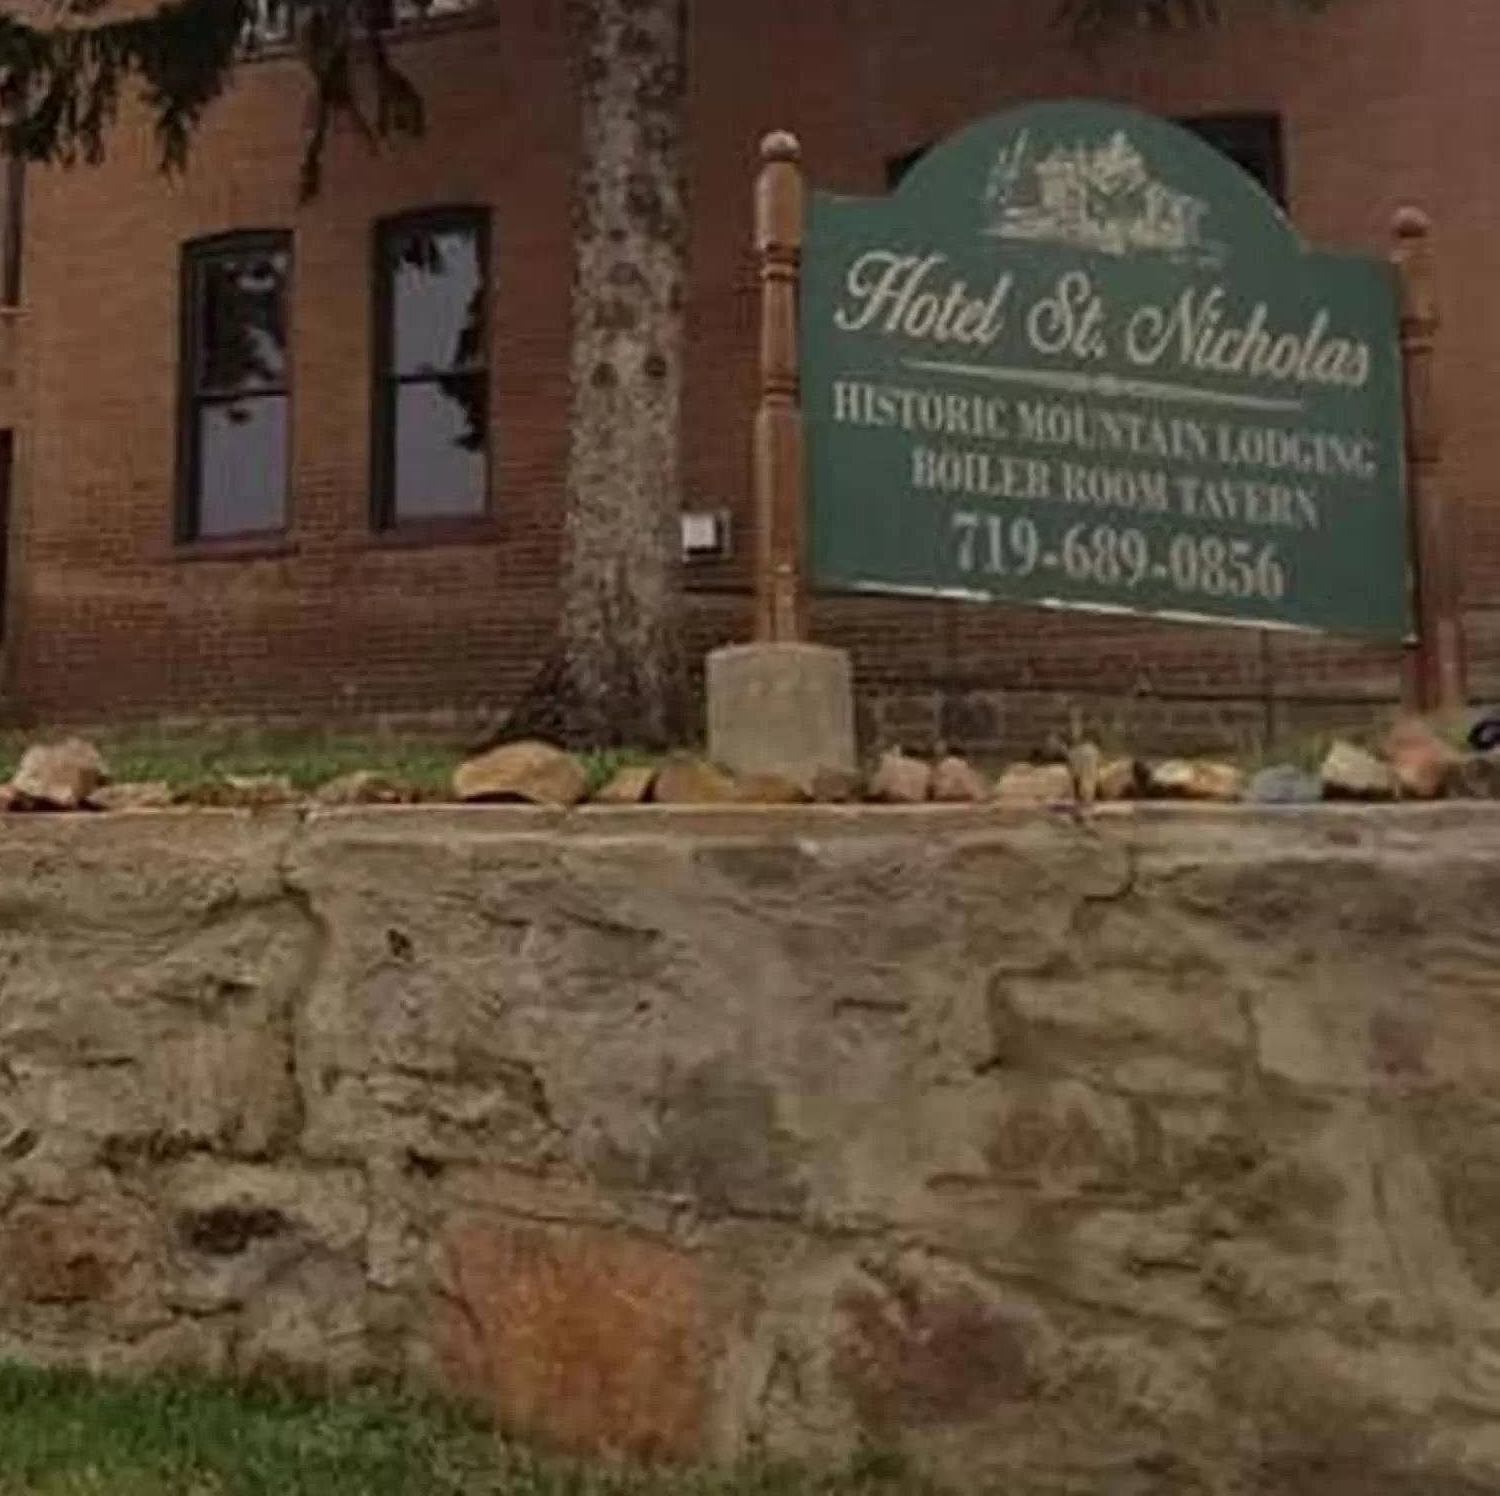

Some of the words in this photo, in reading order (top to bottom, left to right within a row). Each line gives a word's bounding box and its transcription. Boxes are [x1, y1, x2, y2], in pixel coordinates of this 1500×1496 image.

[834, 251, 1008, 346] Hotel
[1027, 271, 1107, 360] St.
[1126, 286, 1370, 387] Nicholas
[833, 381, 1008, 438] HISTORIC
[1018, 401, 1209, 461] MOUNTAIN
[1218, 429, 1377, 480] LODGING
[912, 447, 1051, 502] BOILER
[1064, 465, 1169, 511] ROOM
[1180, 477, 1322, 528] TAVERN
[950, 513, 1285, 600] 719-689-0856
